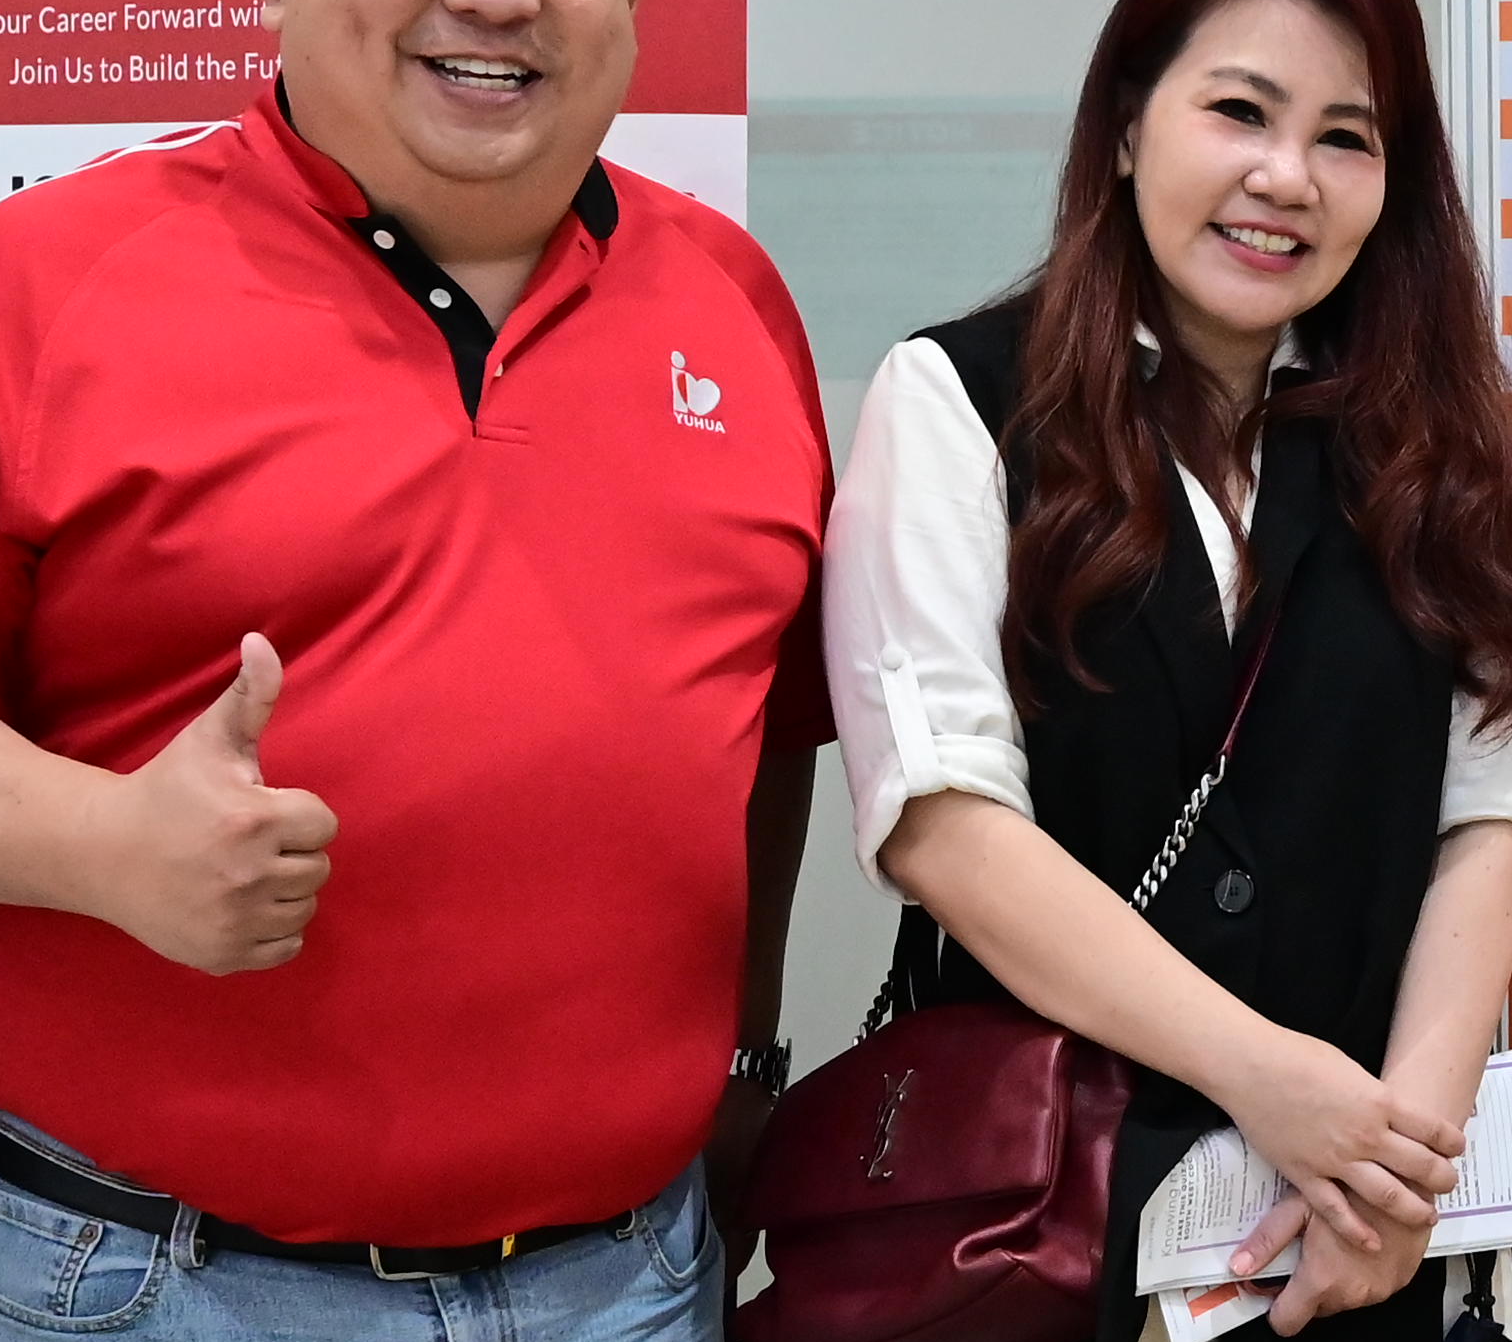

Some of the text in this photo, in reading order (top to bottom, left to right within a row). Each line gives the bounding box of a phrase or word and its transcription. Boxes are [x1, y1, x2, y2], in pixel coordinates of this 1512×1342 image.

[35, 2, 118, 34] Career
[8, 54, 61, 89] Join
[64, 55, 94, 85] Us
[99, 56, 124, 83] to
[127, 50, 191, 83] Build
[195, 49, 238, 81] the
[673, 412, 727, 434] YUHUA
[1161, 1189, 1182, 1258] Knowing
